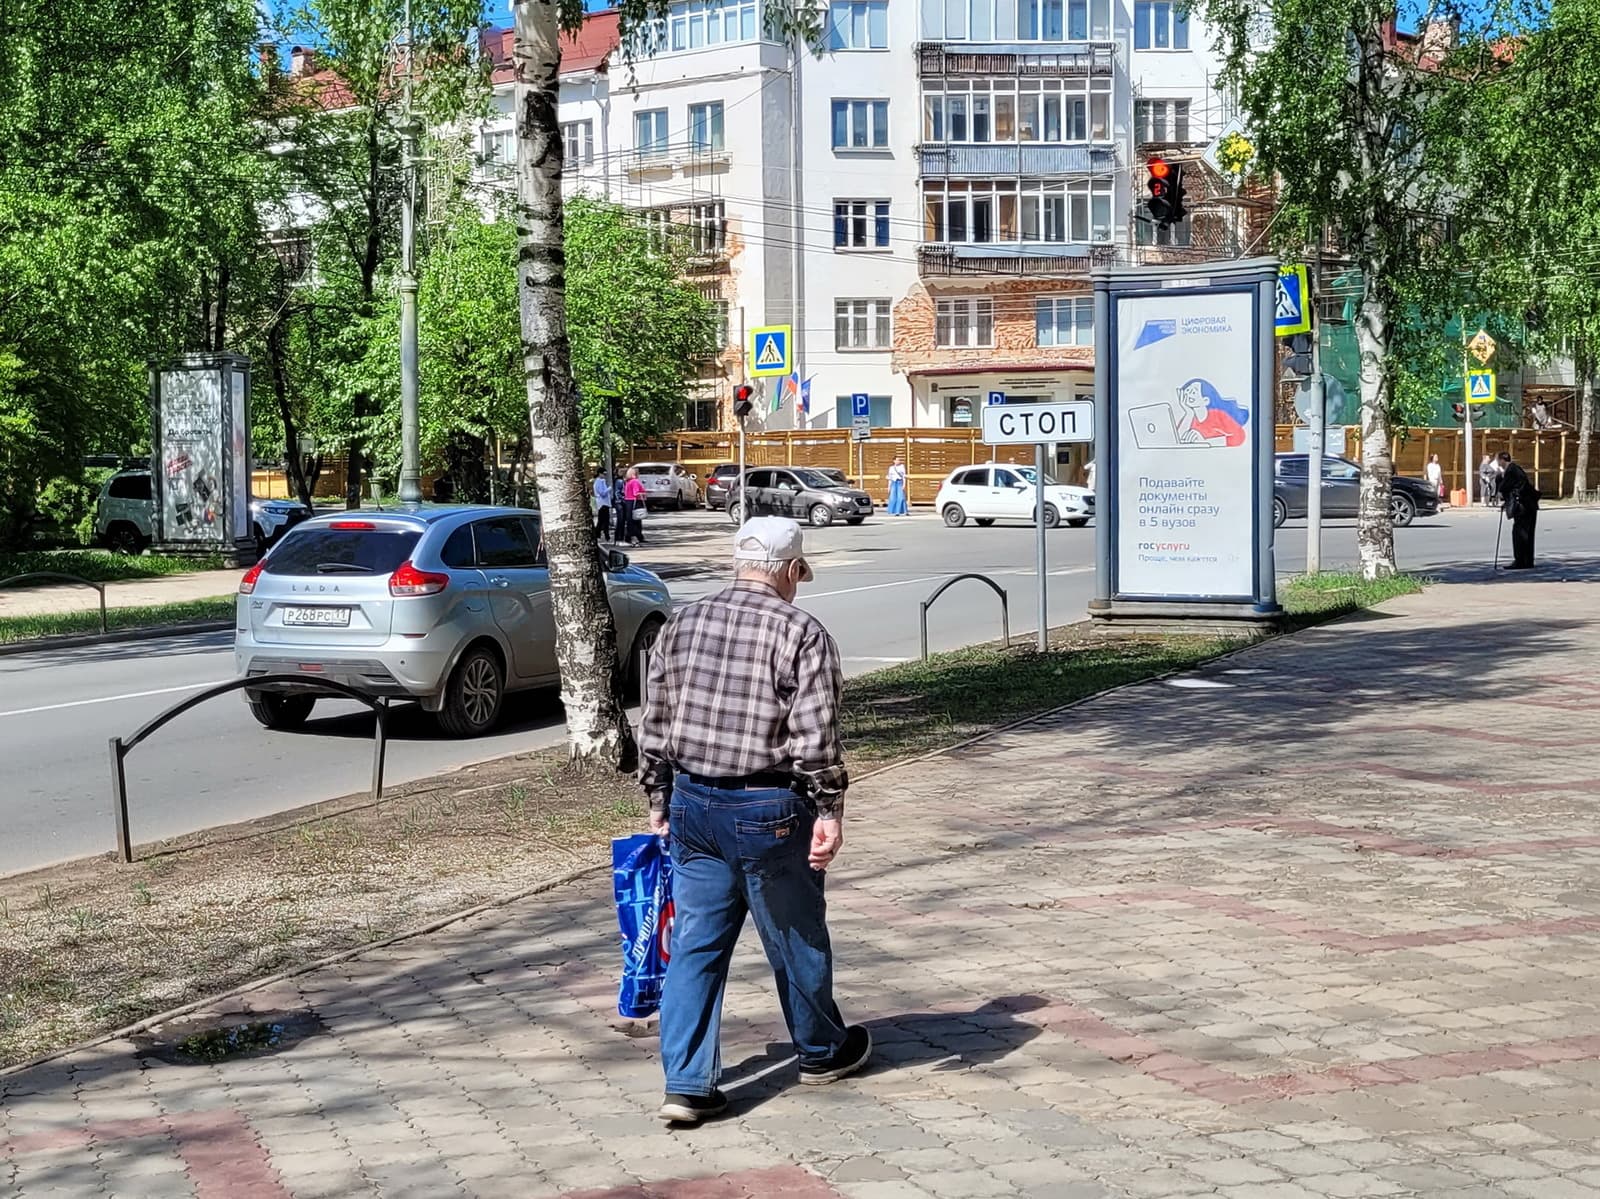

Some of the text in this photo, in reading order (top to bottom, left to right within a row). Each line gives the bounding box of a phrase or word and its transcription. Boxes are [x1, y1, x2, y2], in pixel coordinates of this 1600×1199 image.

[1181, 316, 1226, 326] ЦИФРОВАЯ
[1181, 325, 1233, 335] ЭКОНОМИКА
[856, 395, 867, 414] P
[999, 410, 1077, 437] СТОП
[1139, 477, 1205, 489] Подавайте
[1139, 492, 1208, 503] документы
[1139, 504, 1220, 516] онлайн сразу
[1139, 516, 1196, 530] в 5 вузов
